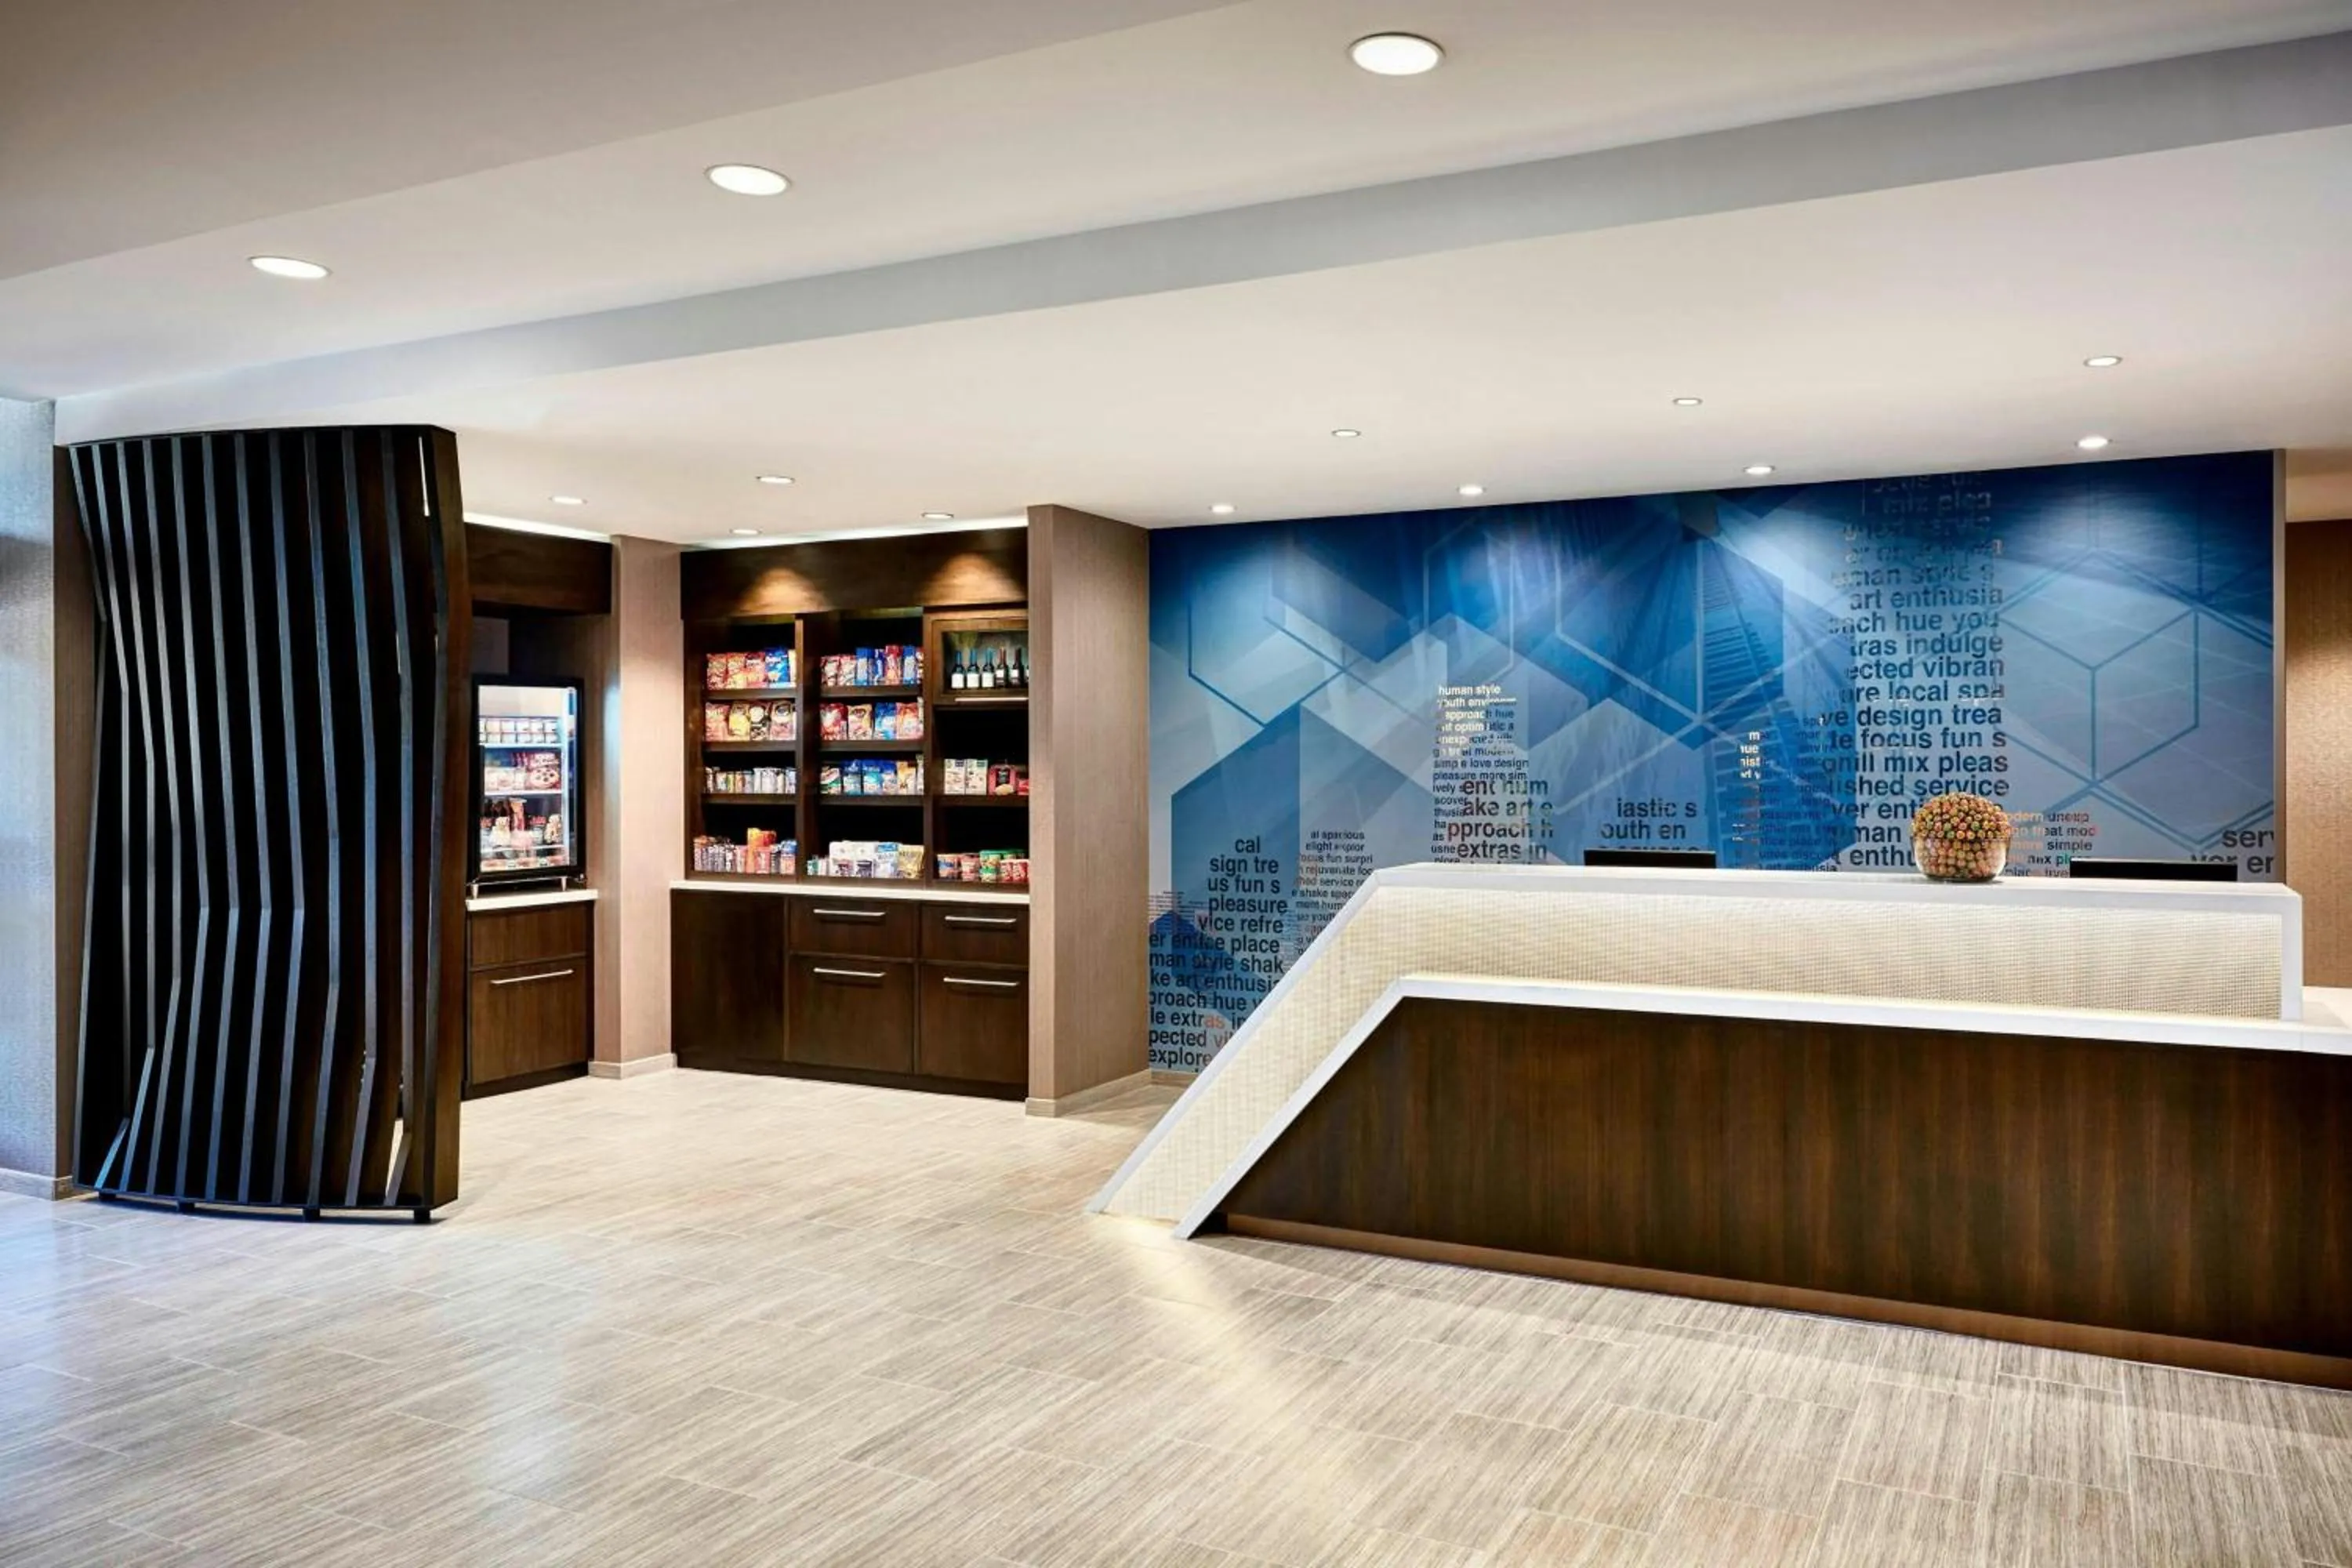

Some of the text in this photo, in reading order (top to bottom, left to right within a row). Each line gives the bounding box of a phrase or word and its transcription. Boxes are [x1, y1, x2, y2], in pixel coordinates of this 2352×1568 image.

[1896, 611, 1943, 632] hue
[1906, 632, 2004, 659] indulge
[1439, 684, 1474, 695] human
[1857, 705, 1943, 731] design
[1952, 704, 2002, 726] trea
[1860, 727, 1933, 749] focus
[1940, 727, 1983, 749] fun
[1470, 757, 1491, 768] love
[1494, 757, 1529, 770] design
[1885, 753, 1929, 774] mix
[1939, 751, 2009, 779] pleas
[1433, 771, 1476, 783] pleasure
[1914, 774, 2010, 797] service
[1235, 836, 1261, 853] cal
[1457, 840, 1522, 859] extras
[2047, 839, 2093, 853] simple
[1210, 855, 1279, 877] sign tre
[1208, 875, 1280, 894] us fun s
[1208, 895, 1287, 916] pleasure
[1240, 915, 1283, 934] refre
[1231, 935, 1280, 956] place
[1240, 954, 1283, 974] shak
[1214, 991, 1247, 1011] hue
